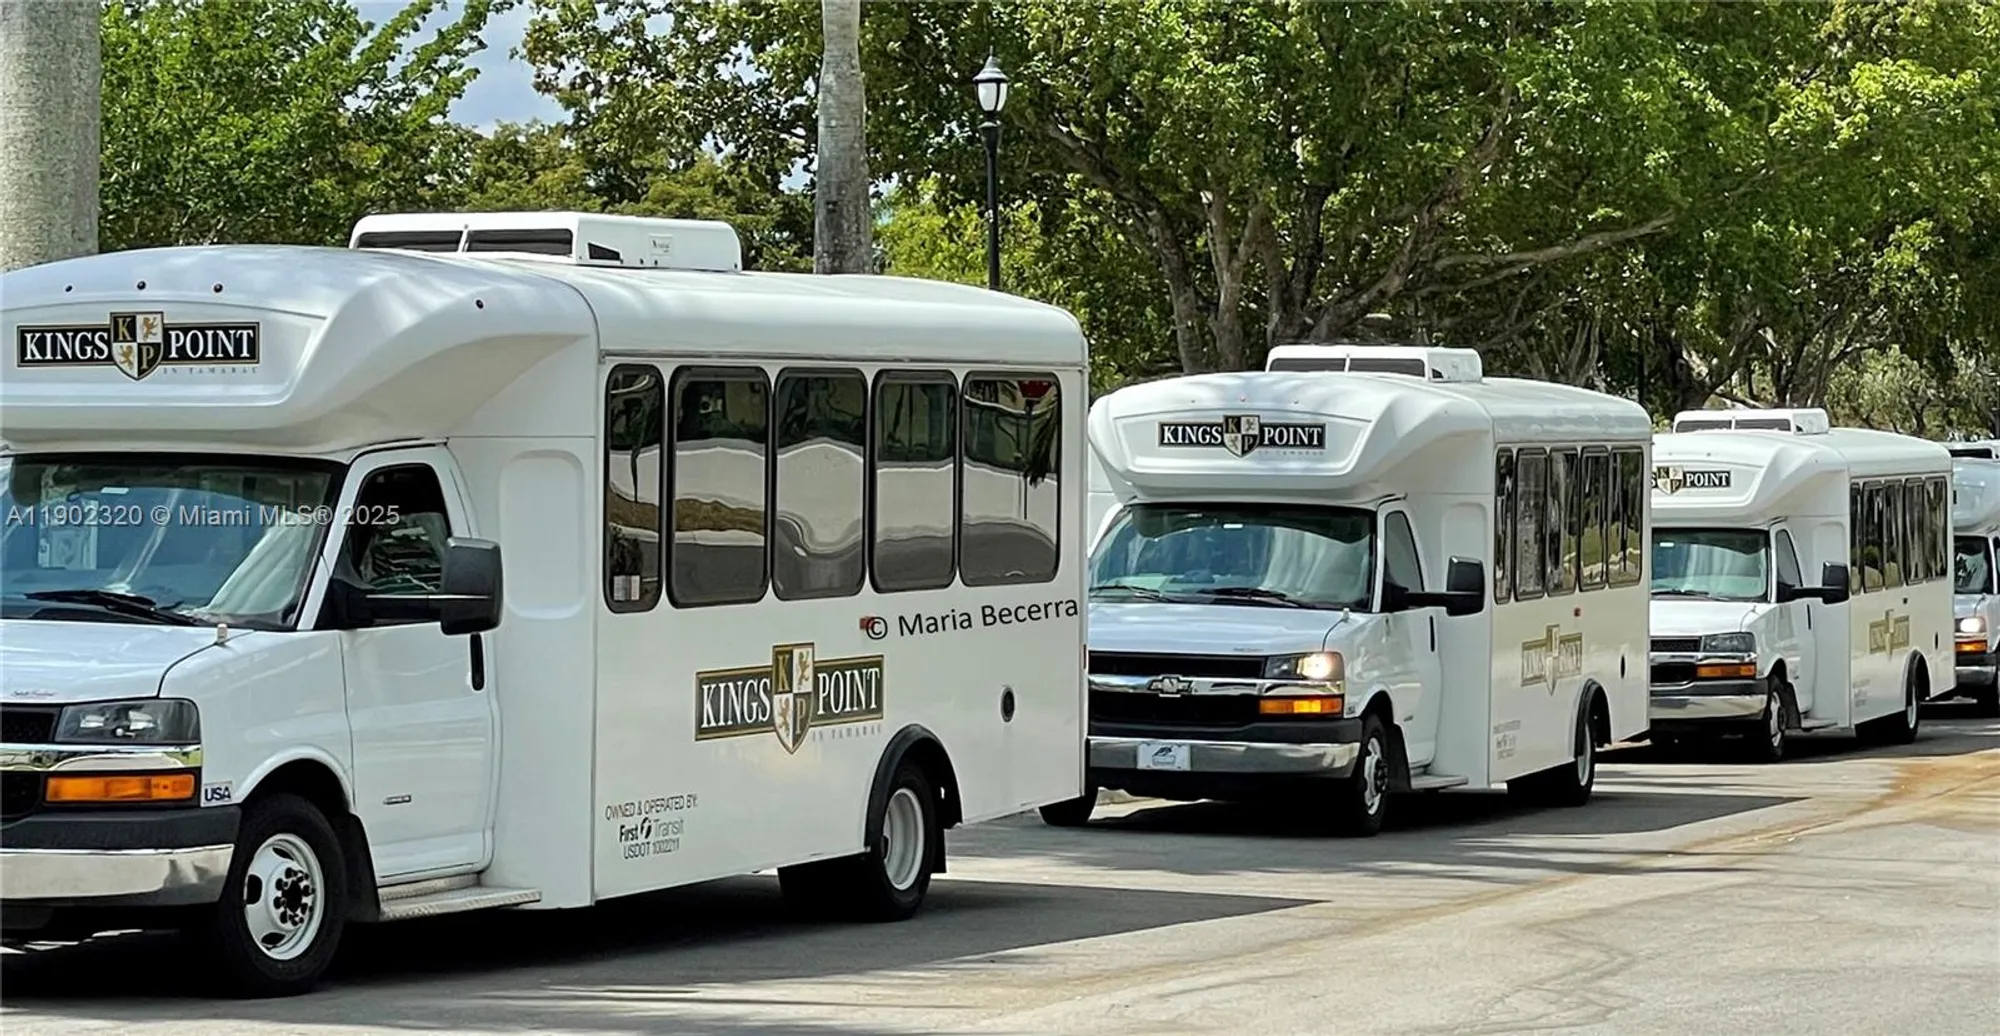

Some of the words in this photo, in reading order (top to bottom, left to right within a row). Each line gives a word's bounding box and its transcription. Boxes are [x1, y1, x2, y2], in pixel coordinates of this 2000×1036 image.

[116, 317, 132, 342] K
[24, 331, 109, 360] KINGS
[168, 329, 254, 358] POINT
[141, 344, 154, 370] P
[1162, 425, 1222, 445] KINGS
[1263, 427, 1322, 446] POINT
[1685, 472, 1729, 487] POINT
[777, 654, 791, 692] K
[701, 677, 771, 728] KINGS
[817, 667, 880, 715] POINT
[204, 786, 231, 801] USA
[605, 802, 636, 820] OWNED
[643, 795, 684, 815] OPERATED
[619, 824, 639, 842] First
[653, 817, 684, 838] Transit
[623, 841, 650, 859] USDOT
